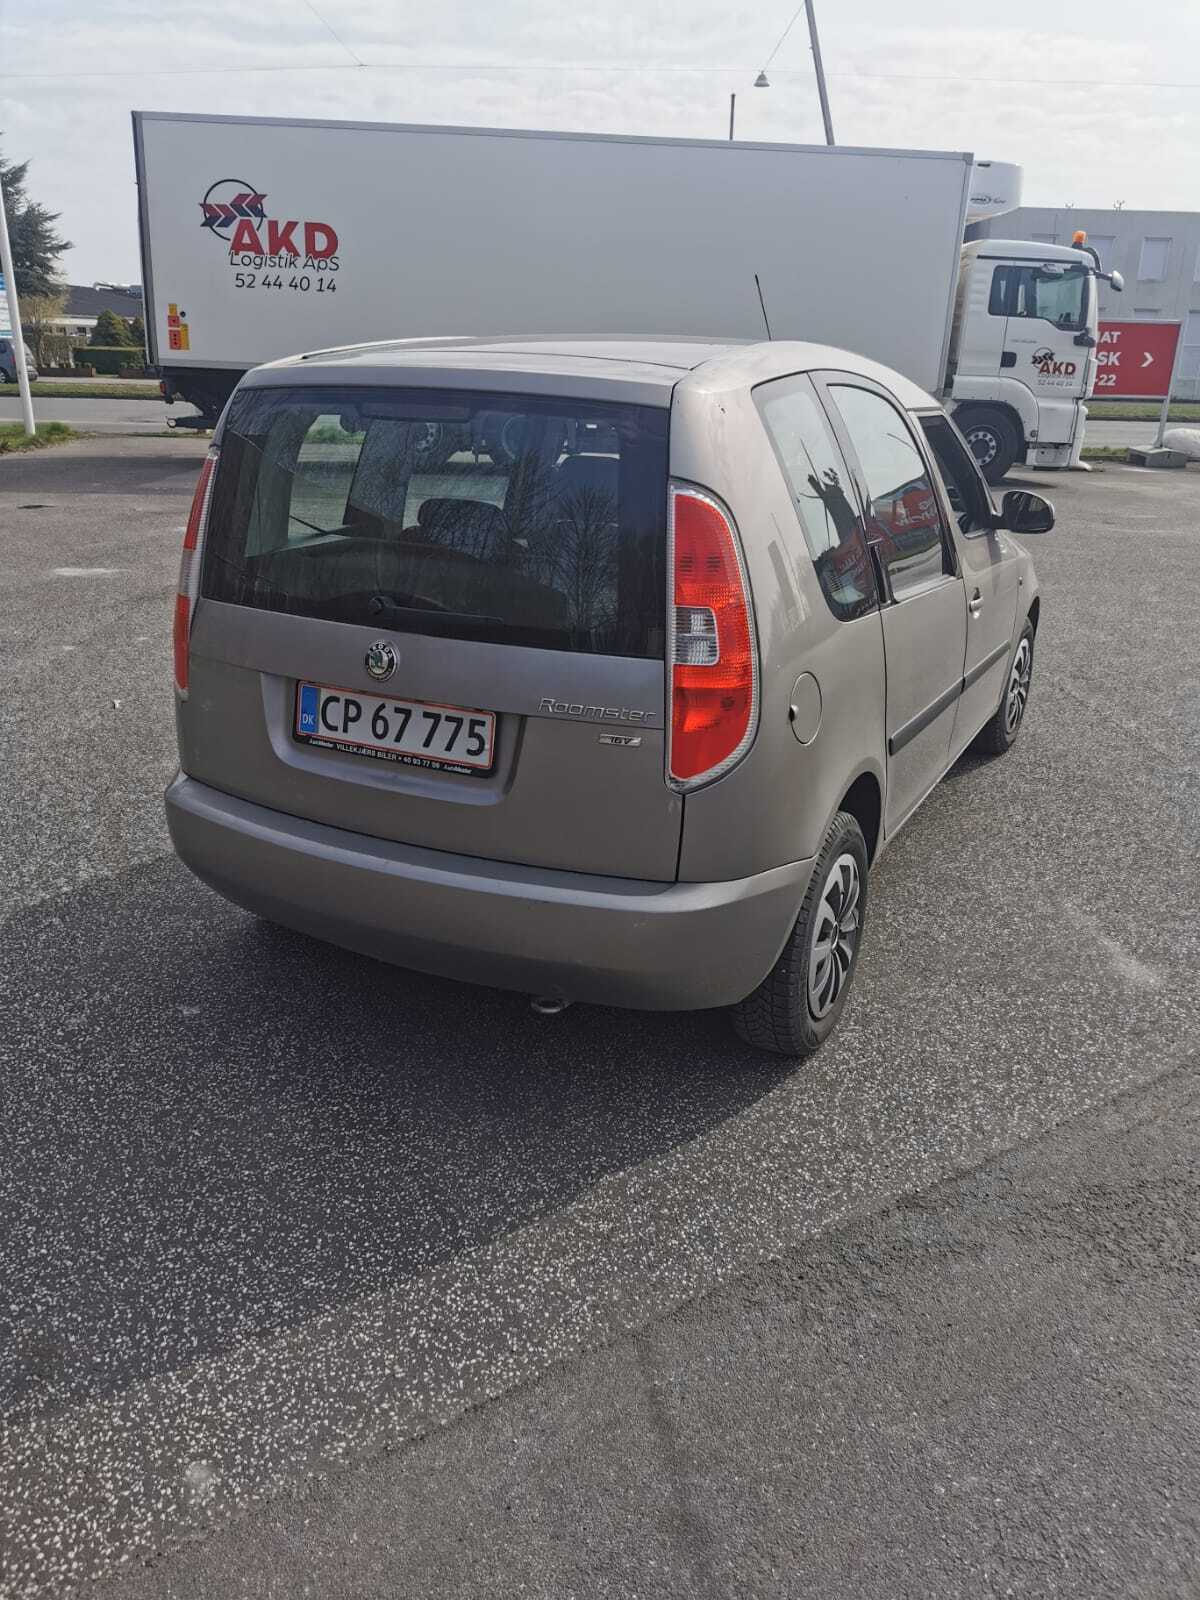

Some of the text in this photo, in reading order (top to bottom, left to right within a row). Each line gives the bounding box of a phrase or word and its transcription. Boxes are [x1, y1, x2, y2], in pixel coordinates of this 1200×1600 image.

[230, 218, 339, 259] AKD
[229, 251, 340, 273] Logistik ApS
[235, 273, 337, 293] 52 44 40 14
[1040, 361, 1076, 375] AKD
[538, 697, 657, 721] Roomster
[302, 714, 314, 726] DK
[321, 695, 486, 757] CP 67 775
[377, 751, 397, 761] BILER
